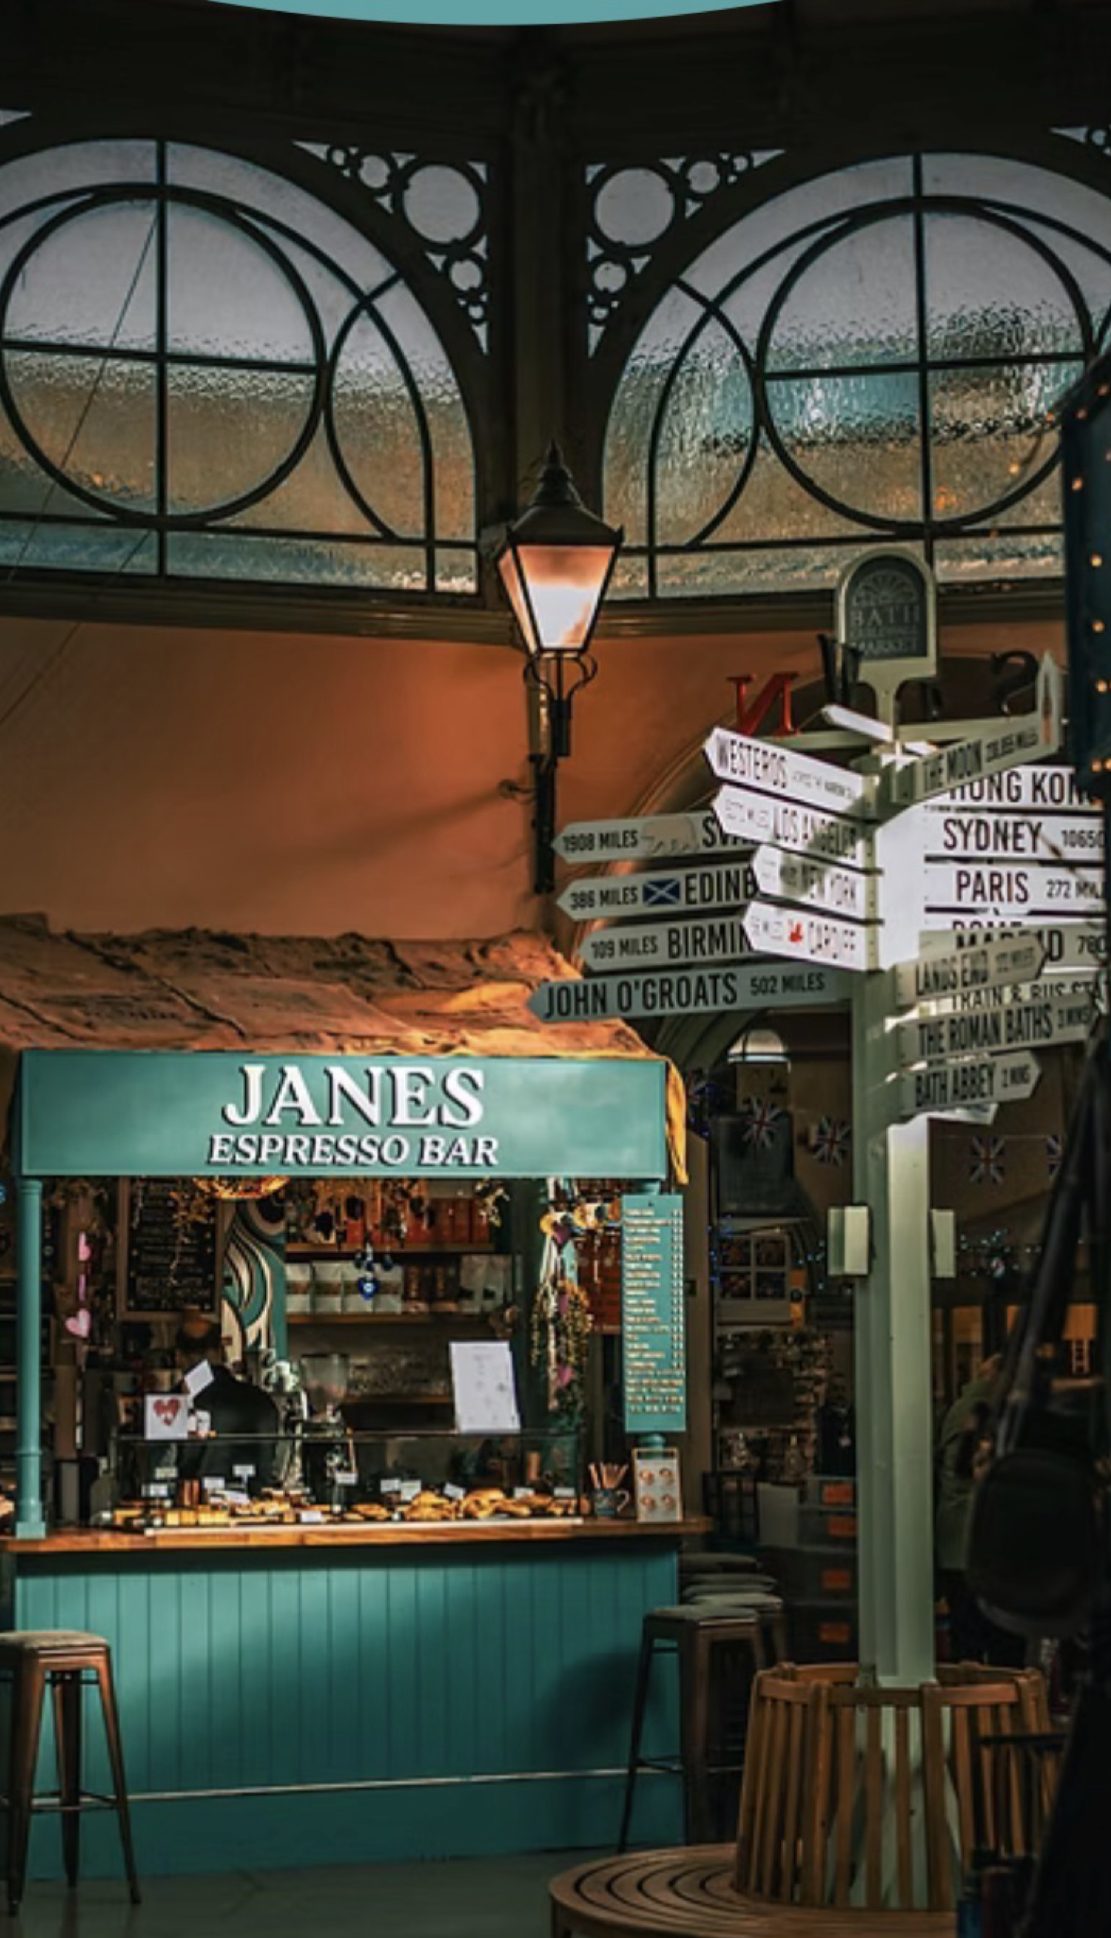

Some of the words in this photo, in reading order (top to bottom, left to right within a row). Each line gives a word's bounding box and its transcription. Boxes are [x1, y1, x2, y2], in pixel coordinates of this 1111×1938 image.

[850, 604, 920, 627] BATH
[946, 739, 983, 783] MOON
[600, 830, 638, 850] MILES
[943, 818, 1042, 853] SYDNEY
[600, 887, 638, 906] MILES
[956, 870, 1029, 904] PARIS
[1047, 880, 1070, 898] 272
[591, 941, 614, 959] 109
[619, 936, 657, 956] MILES
[961, 949, 989, 988] END
[545, 982, 607, 1020] JOHN
[617, 972, 738, 1012] O'GROATS
[750, 976, 778, 996] 502
[782, 972, 825, 994] MILES
[919, 1020, 944, 1056] THE
[949, 1011, 1002, 1050] ROMAN
[1005, 1002, 1053, 1044] BATHS
[222, 1064, 485, 1128] JANES
[915, 1069, 949, 1107] BATH
[953, 1062, 997, 1100] ABBEY
[208, 1134, 410, 1166] ESPRESSO
[419, 1135, 500, 1166] BAR
